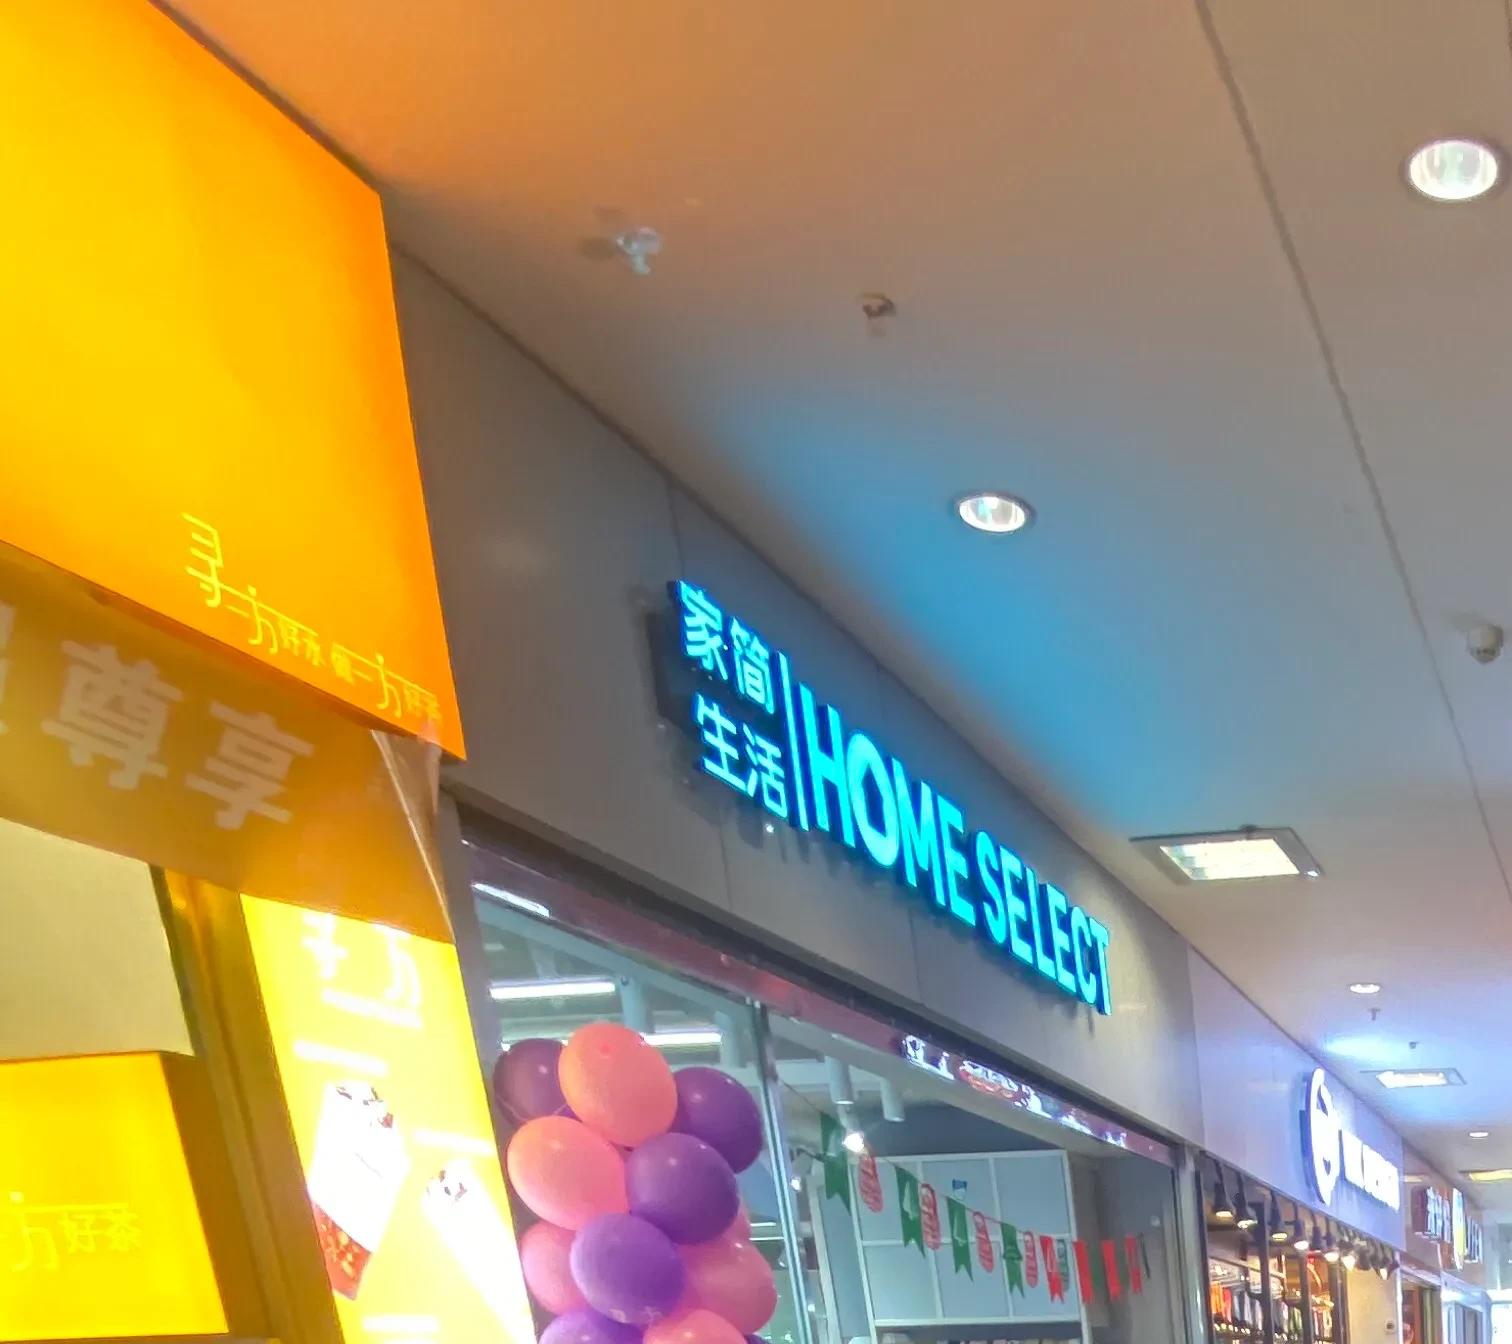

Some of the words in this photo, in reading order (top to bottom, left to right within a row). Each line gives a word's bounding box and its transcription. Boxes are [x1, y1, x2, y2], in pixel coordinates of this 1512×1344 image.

[678, 579, 776, 715] 家简
[0, 602, 315, 832] 尊享
[693, 691, 789, 819] 生活
[800, 682, 977, 928] HOME
[975, 829, 1112, 1016] SELECT
[0, 1190, 144, 1273] 方好茶
